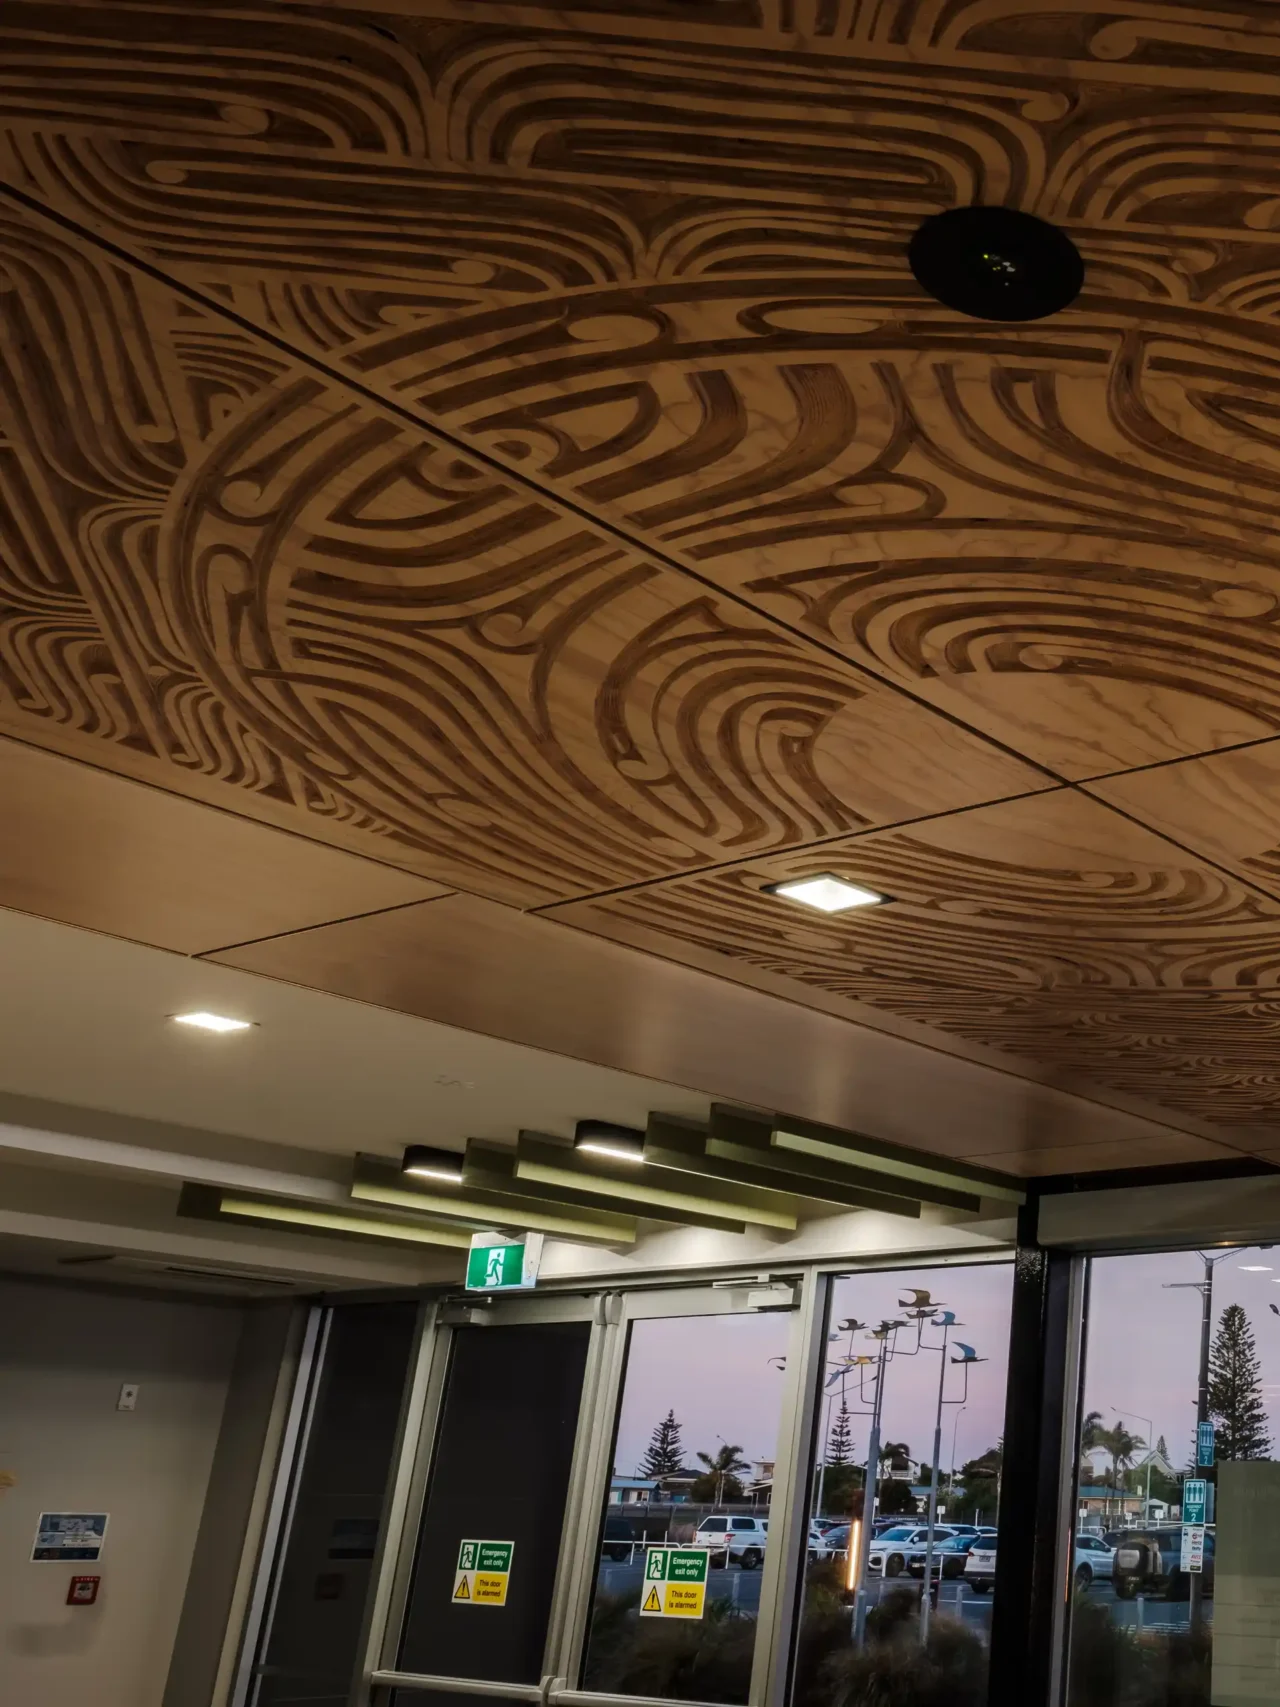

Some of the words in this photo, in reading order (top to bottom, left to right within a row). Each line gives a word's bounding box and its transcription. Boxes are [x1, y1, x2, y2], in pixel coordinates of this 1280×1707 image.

[1191, 1513, 1196, 1522] 2
[482, 1549, 508, 1558] Emergency
[672, 1557, 703, 1566] Emergency
[686, 1569, 699, 1577] only
